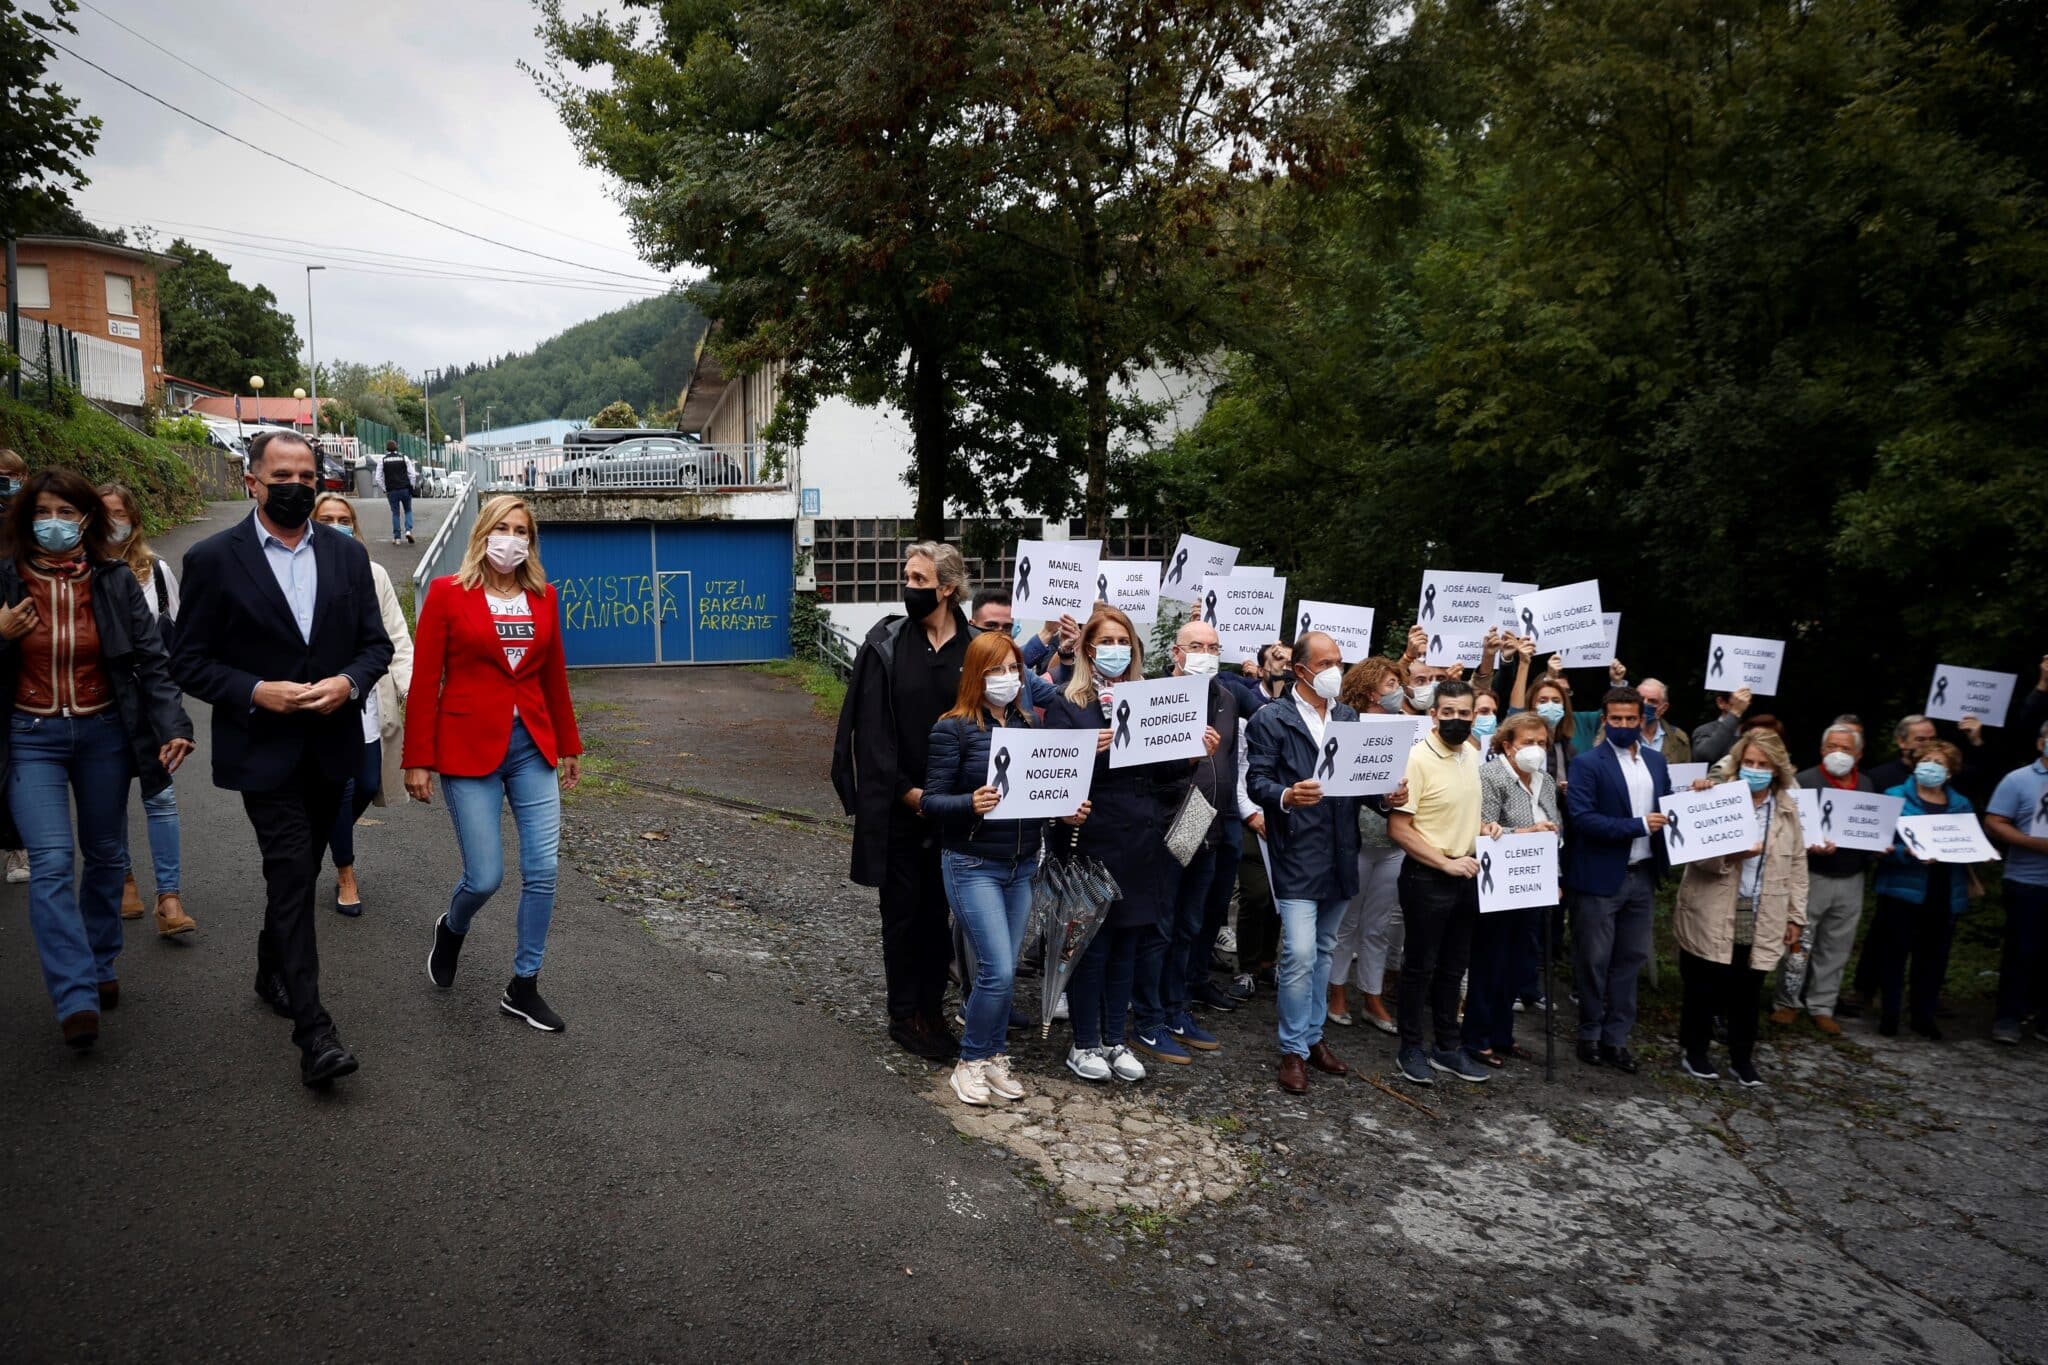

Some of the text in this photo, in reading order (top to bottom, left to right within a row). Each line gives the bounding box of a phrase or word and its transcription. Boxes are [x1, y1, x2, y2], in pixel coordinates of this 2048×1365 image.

[1048, 560, 1082, 572] MANUEL
[706, 580, 744, 594] UTZI
[1049, 578, 1079, 590] RIVERA
[1466, 584, 1492, 594] ÁNGEL
[1227, 589, 1274, 599] CRISTÓBAL
[700, 594, 766, 614] BAKEAN
[1042, 594, 1082, 608] SÁNCHEZ
[1452, 600, 1480, 608] RAMOS
[490, 605, 498, 613] O
[566, 598, 678, 630] KANPORA
[1234, 606, 1264, 615] COLÓN
[700, 614, 778, 630] ARRASATE
[1442, 615, 1484, 623] SAAVEDRA
[1543, 611, 1562, 621] LUIS
[496, 625, 535, 635] UIEN
[1220, 624, 1276, 632] DE CARVAJAL
[1314, 624, 1368, 636] CONSTANTINO
[1544, 619, 1596, 636] HORTIGÜELA
[506, 649, 528, 658] PA
[1150, 693, 1190, 706] MANUEL
[1140, 711, 1197, 728] RODRÍGUEZ
[1144, 732, 1192, 746] TABOADA
[1362, 735, 1393, 746] JESÚS
[1031, 748, 1079, 758] ANTONIO
[1354, 752, 1393, 764] ÁBALOS
[1026, 768, 1078, 779] NOGUERA
[1350, 770, 1390, 782] JIMÉNEZ
[1029, 786, 1069, 800] GARCÍA
[1687, 796, 1742, 814] GUILLERMO
[1694, 813, 1743, 829] QUINTANA
[1701, 829, 1744, 845] LACACCI
[1508, 865, 1541, 876] PERRET
[1509, 883, 1542, 894] BENIAIN
